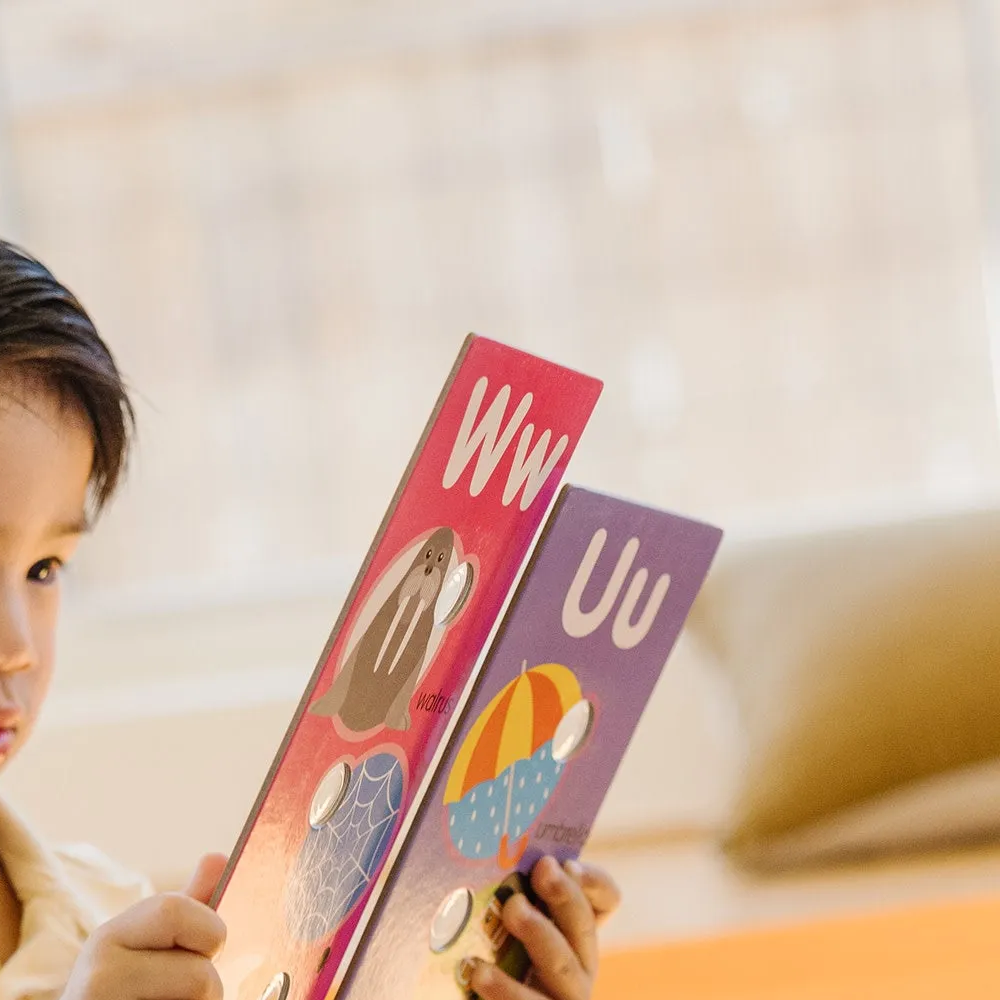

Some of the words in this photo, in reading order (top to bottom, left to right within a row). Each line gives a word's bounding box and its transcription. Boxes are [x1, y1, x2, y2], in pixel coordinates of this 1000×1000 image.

[442, 376, 569, 511] Ww
[562, 527, 671, 650] Uu
[416, 688, 453, 714] walrus
